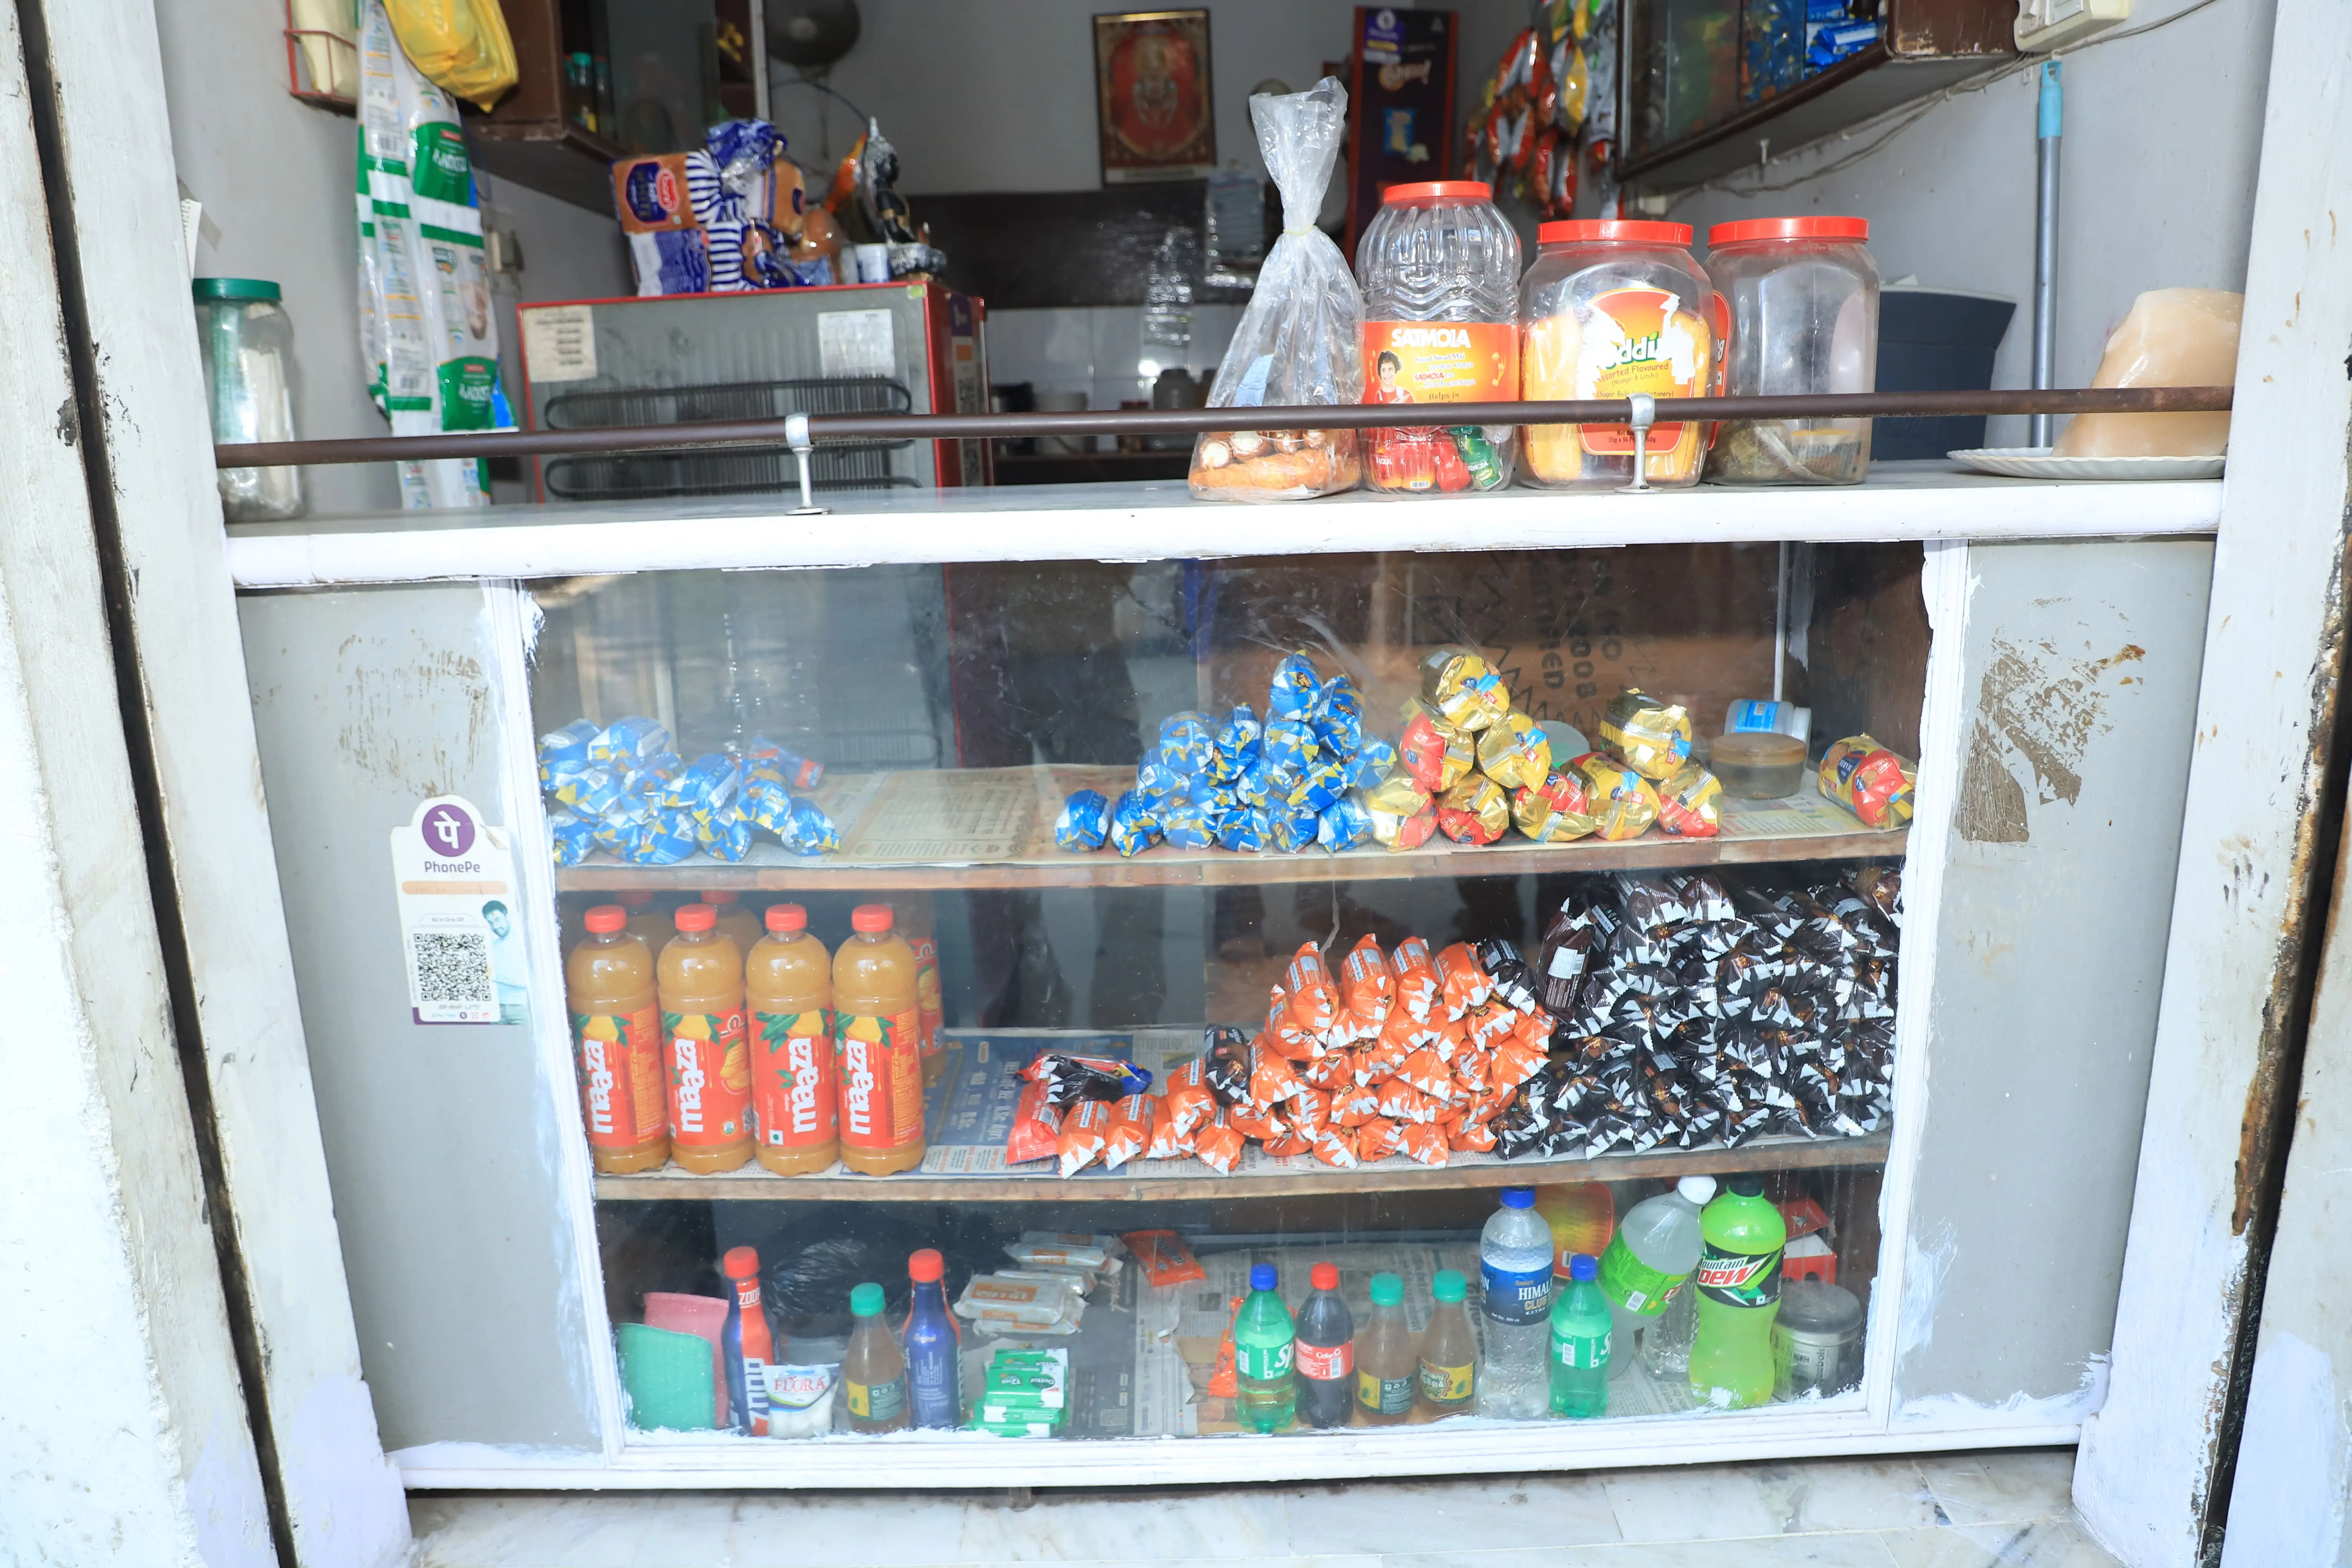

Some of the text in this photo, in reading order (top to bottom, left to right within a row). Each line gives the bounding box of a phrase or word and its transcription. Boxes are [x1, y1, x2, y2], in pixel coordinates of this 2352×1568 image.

[1391, 328, 1472, 348] SATMOLA
[1434, 353, 1451, 361] Swad
[1453, 361, 1474, 369] khaya
[1631, 362, 1669, 374] Flavoured
[1414, 373, 1444, 381] SATMOLA
[1447, 379, 1476, 387] pachaya
[1612, 378, 1632, 387] (Mango
[1640, 372, 1658, 381] Litchi)
[1429, 392, 1450, 400] Helps
[1597, 390, 1615, 399] (Sugar
[433, 811, 461, 850] पे
[424, 861, 481, 874] PhonePe
[584, 1039, 614, 1134] maaza
[675, 1038, 705, 1133] maaza
[789, 1038, 819, 1134] maaza
[846, 1039, 874, 1135] maaza
[1518, 1276, 1553, 1301] HIMALA
[738, 1287, 761, 1306] ZOOP
[1524, 1295, 1547, 1311] CLUB
[1525, 1306, 1546, 1316] EXTRA
[774, 1376, 826, 1392] FLORA
